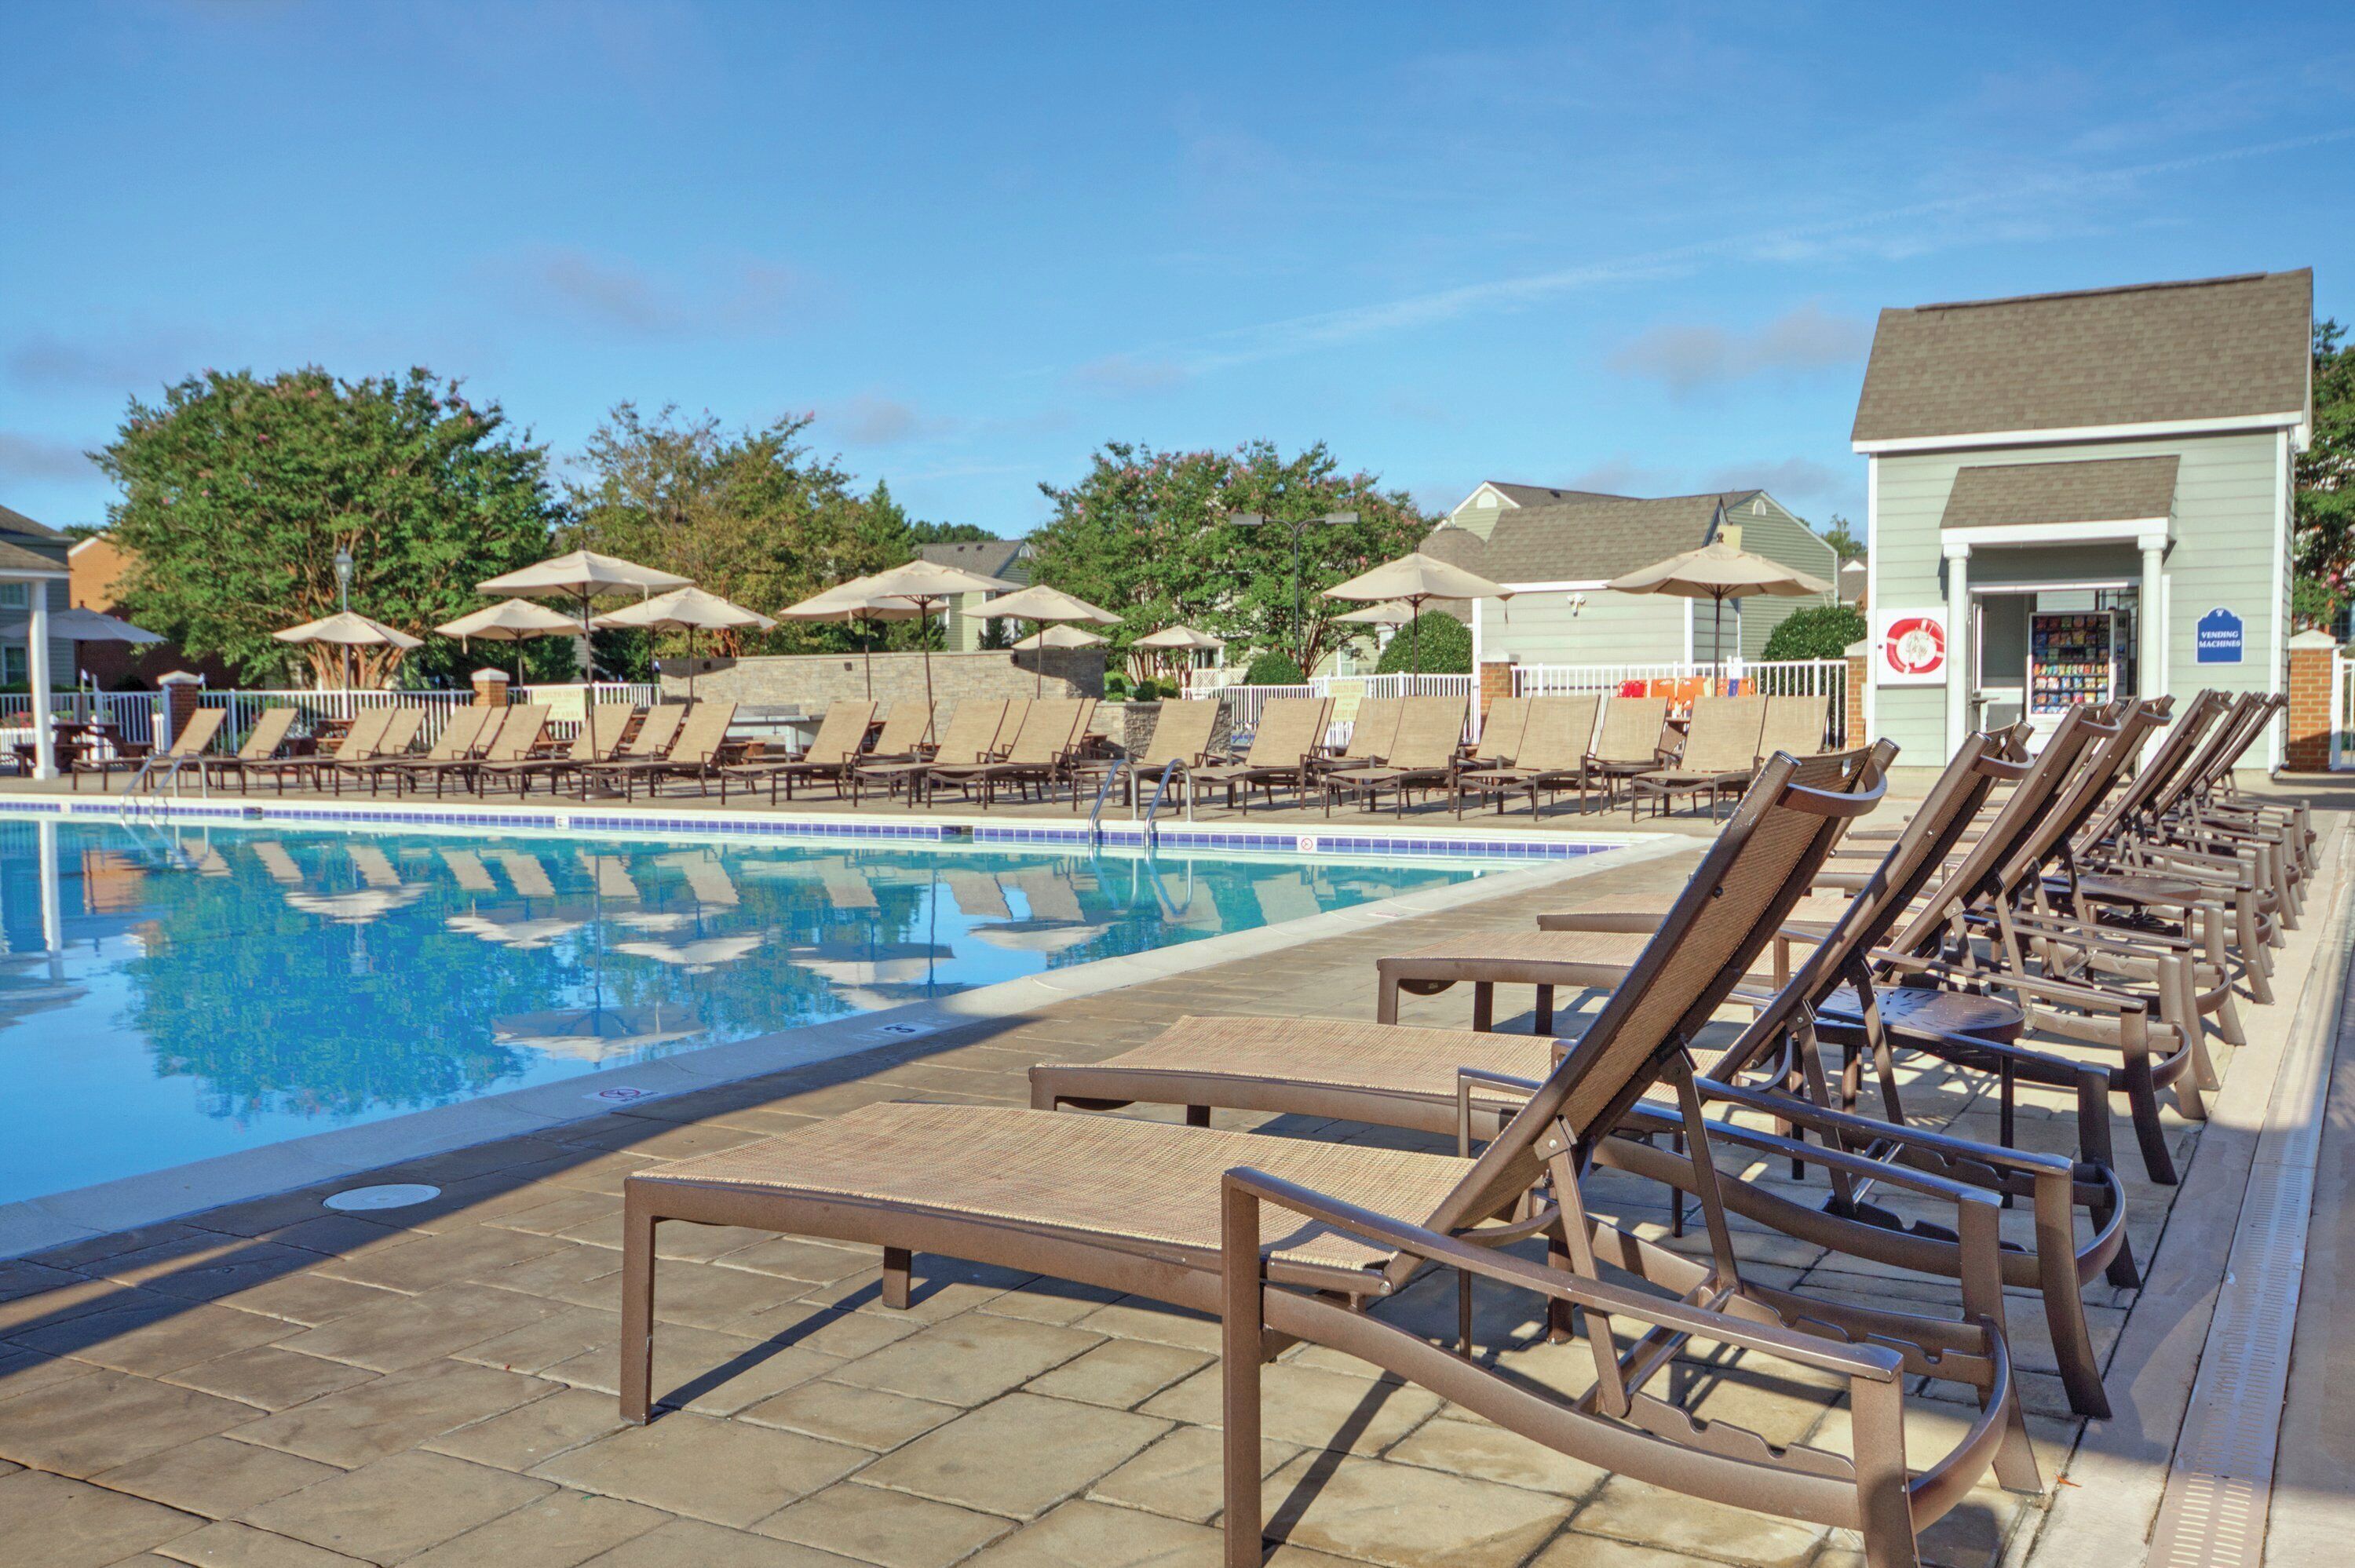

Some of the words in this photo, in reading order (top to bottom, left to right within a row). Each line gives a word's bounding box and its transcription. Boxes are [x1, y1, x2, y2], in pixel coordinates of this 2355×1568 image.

[2201, 630, 2238, 639] VENDING
[2199, 640, 2241, 648] MACHINES
[563, 690, 580, 698] ONLY
